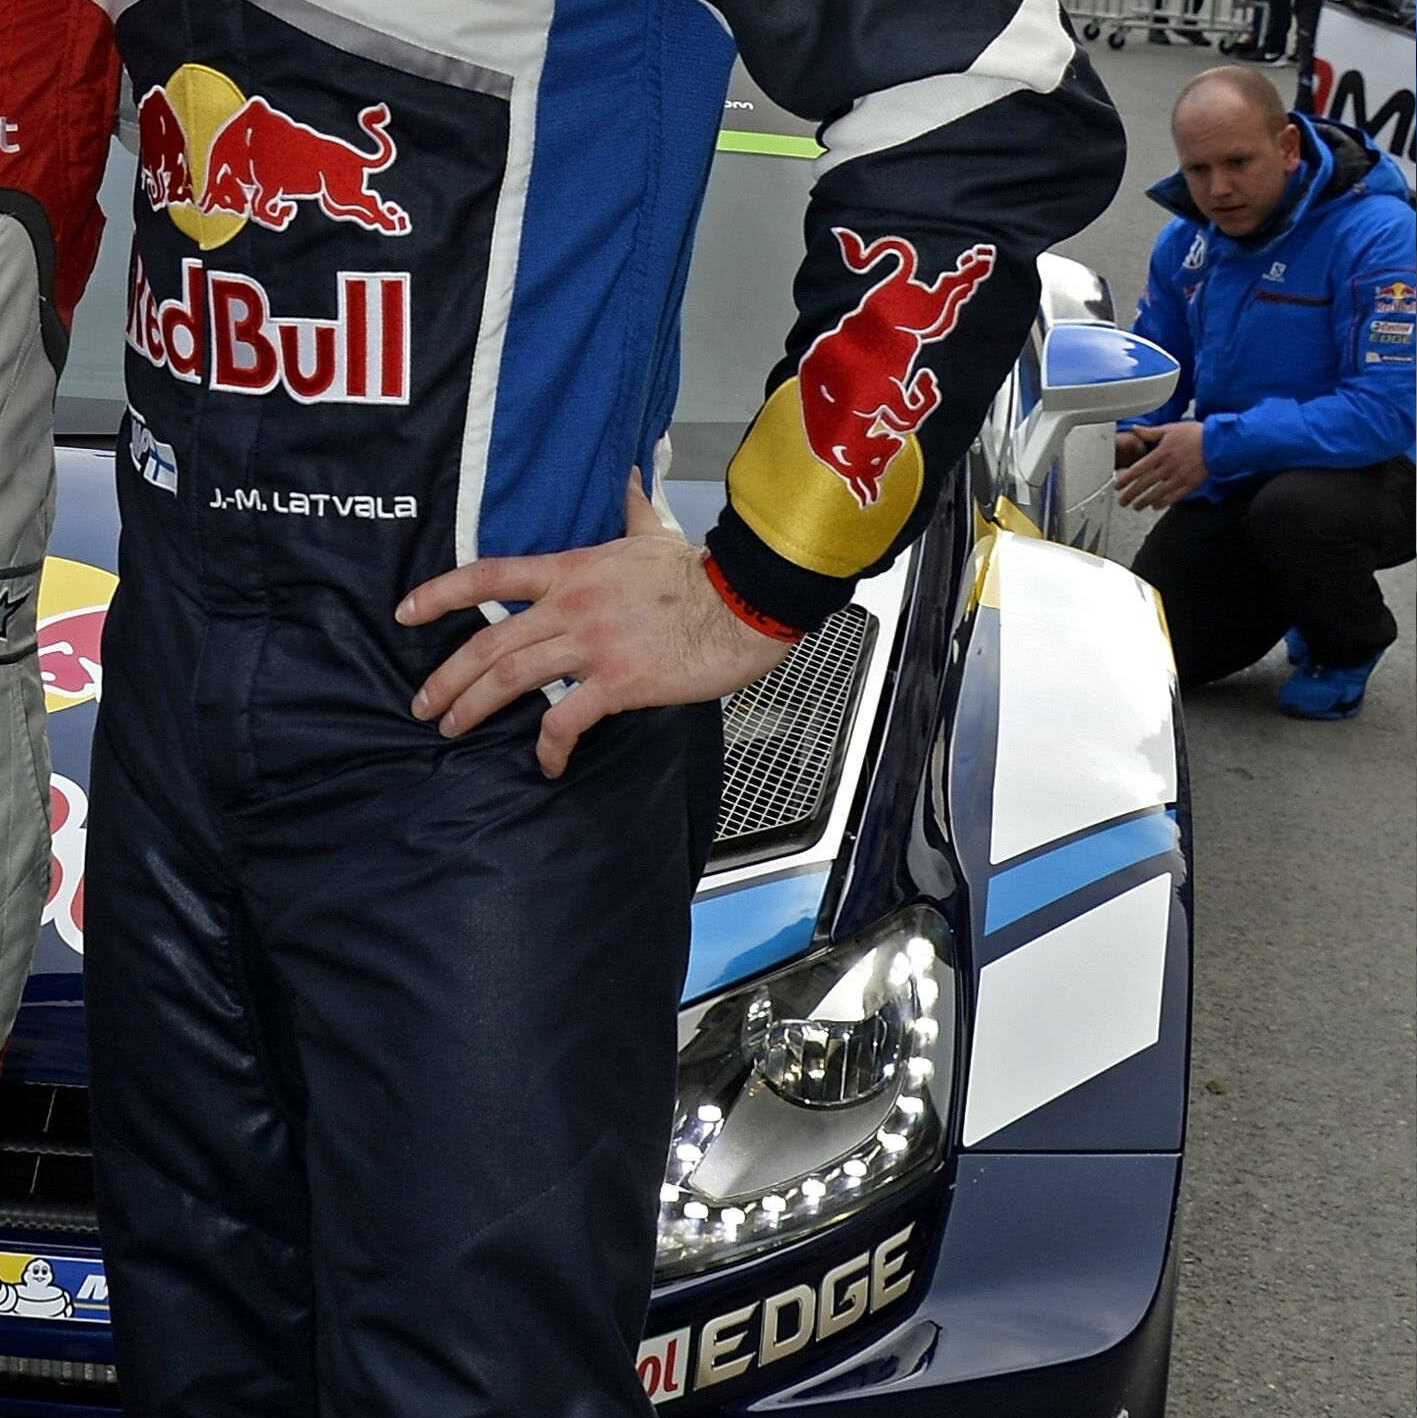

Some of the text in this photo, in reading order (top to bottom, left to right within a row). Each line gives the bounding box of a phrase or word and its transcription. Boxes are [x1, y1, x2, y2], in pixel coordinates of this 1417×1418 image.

[207, 269, 411, 405] Bull
[210, 488, 267, 512] J.-M.
[694, 1220, 915, 1391] EDGE
